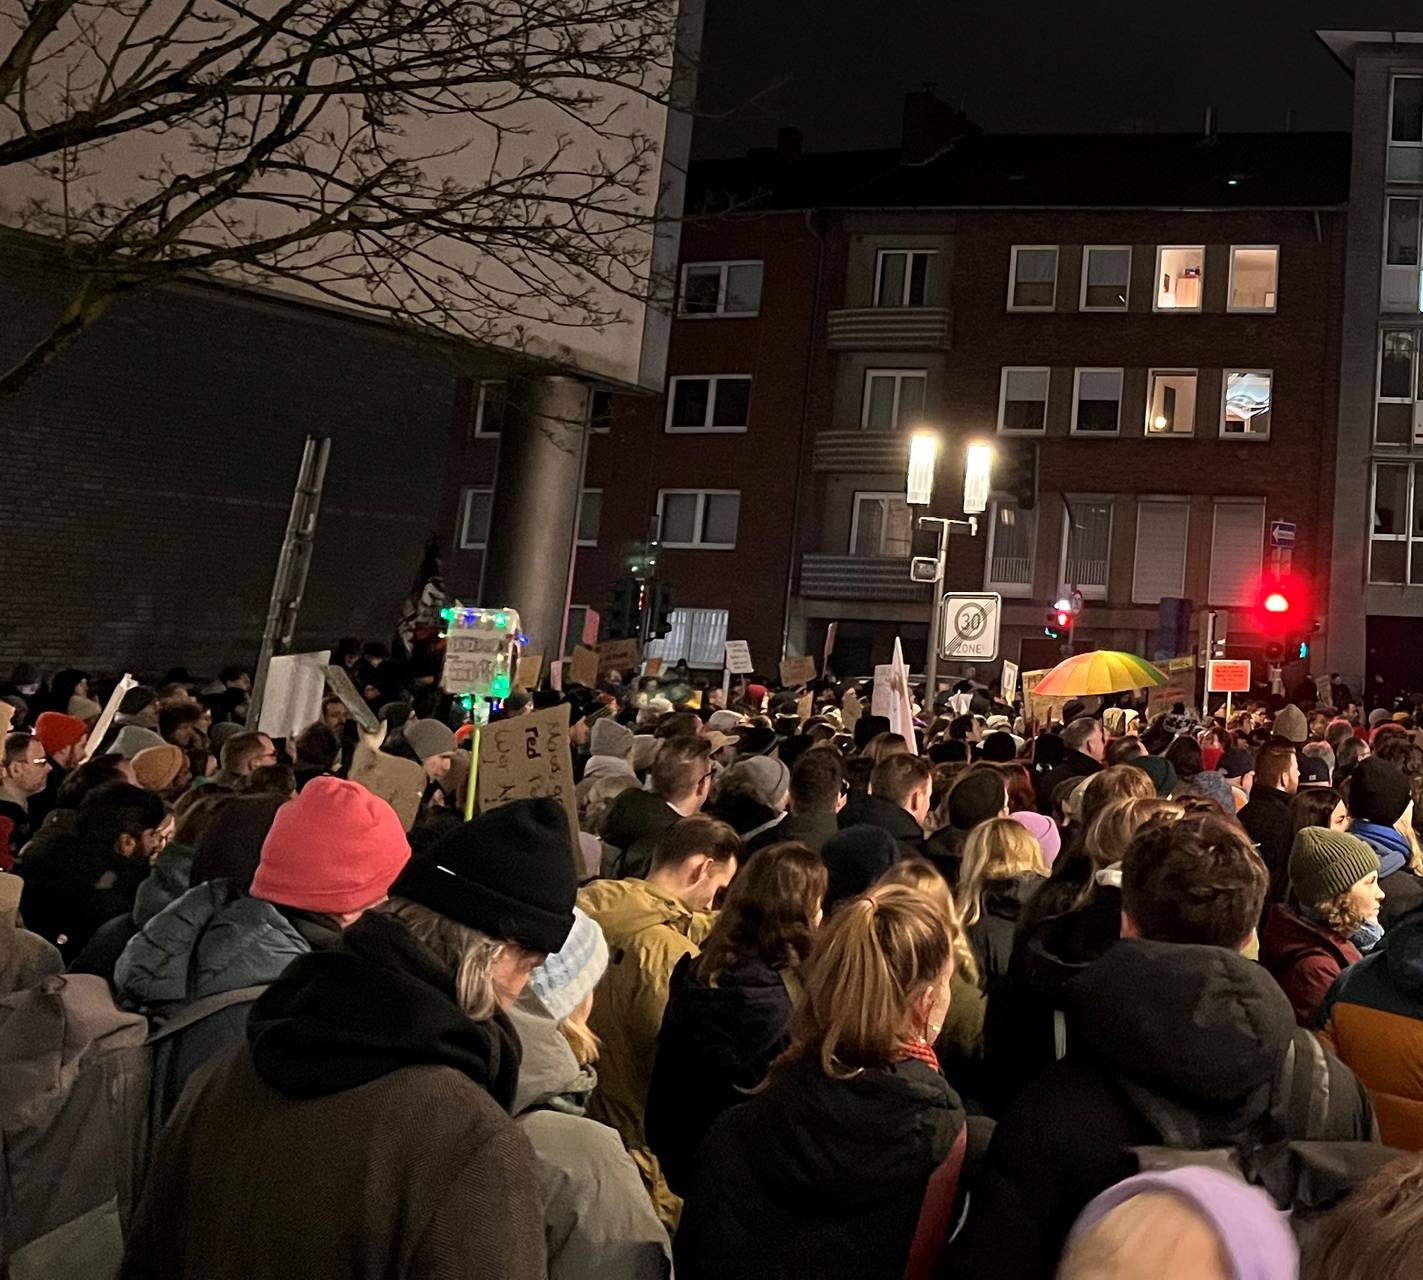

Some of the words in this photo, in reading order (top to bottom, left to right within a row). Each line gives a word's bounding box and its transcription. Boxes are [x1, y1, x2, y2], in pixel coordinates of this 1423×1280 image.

[961, 612, 981, 630] 30
[956, 643, 982, 654] ZONE
[525, 727, 541, 759] red
